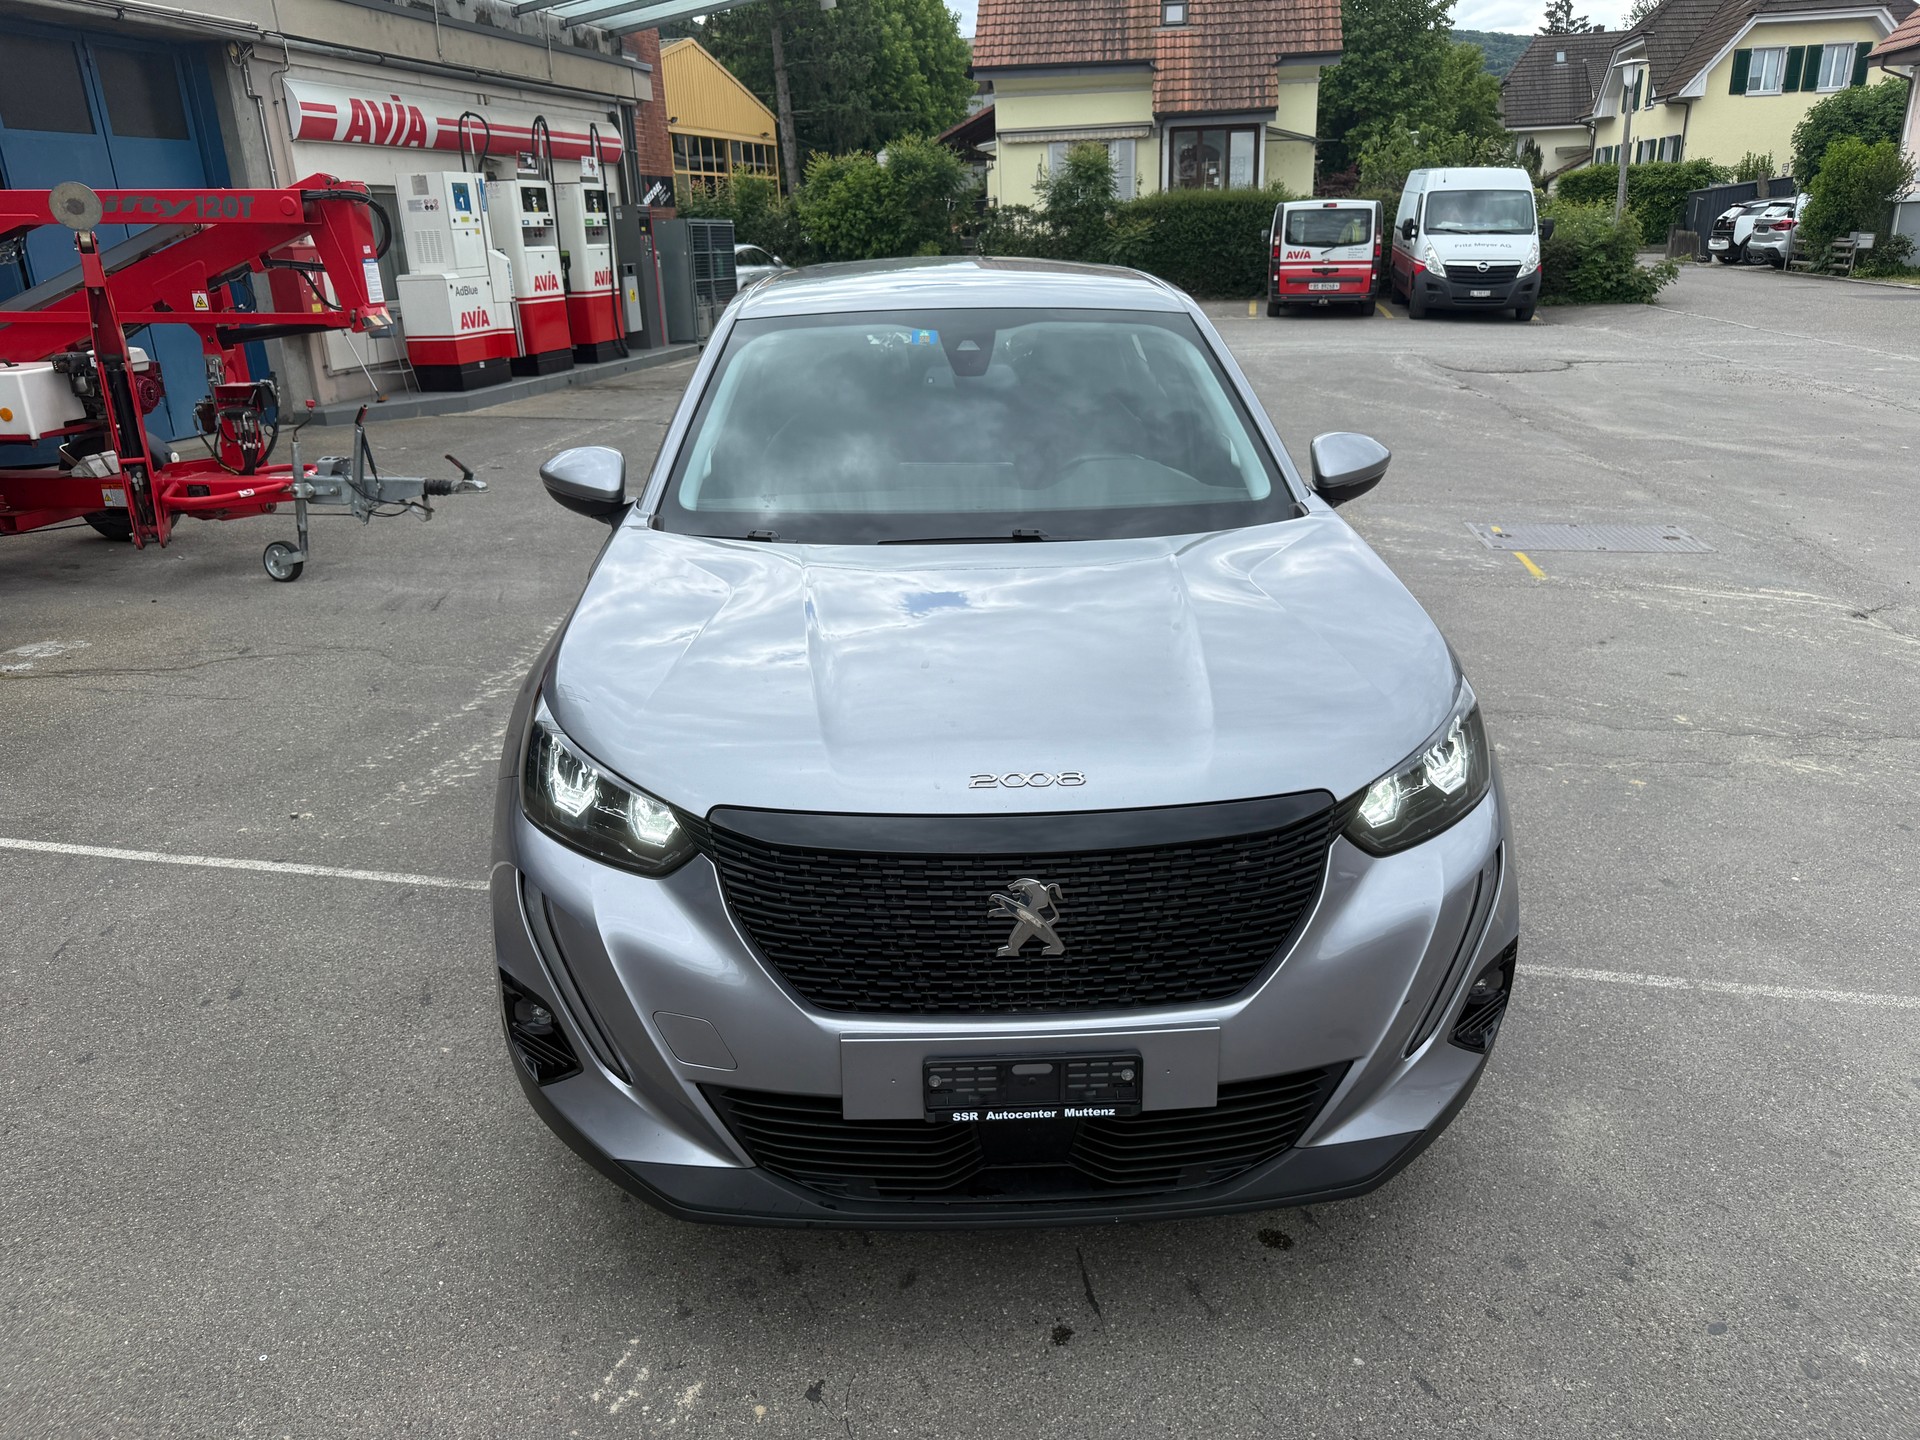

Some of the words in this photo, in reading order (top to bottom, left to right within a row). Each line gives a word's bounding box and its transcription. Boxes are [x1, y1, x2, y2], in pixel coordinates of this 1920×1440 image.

[343, 94, 427, 148] AVIA
[103, 195, 193, 218] ifty
[195, 196, 255, 219] 120T
[459, 196, 466, 209] 1
[531, 196, 538, 208] 2
[1286, 249, 1311, 260] AVIA
[534, 271, 559, 292] AVIA
[455, 285, 478, 297] AdBlue
[461, 306, 491, 330] AVIA
[968, 771, 1087, 789] 2008
[952, 1111, 979, 1122] SSR
[986, 1109, 1058, 1121] Autocenter
[1064, 1107, 1116, 1118] Muttenz
